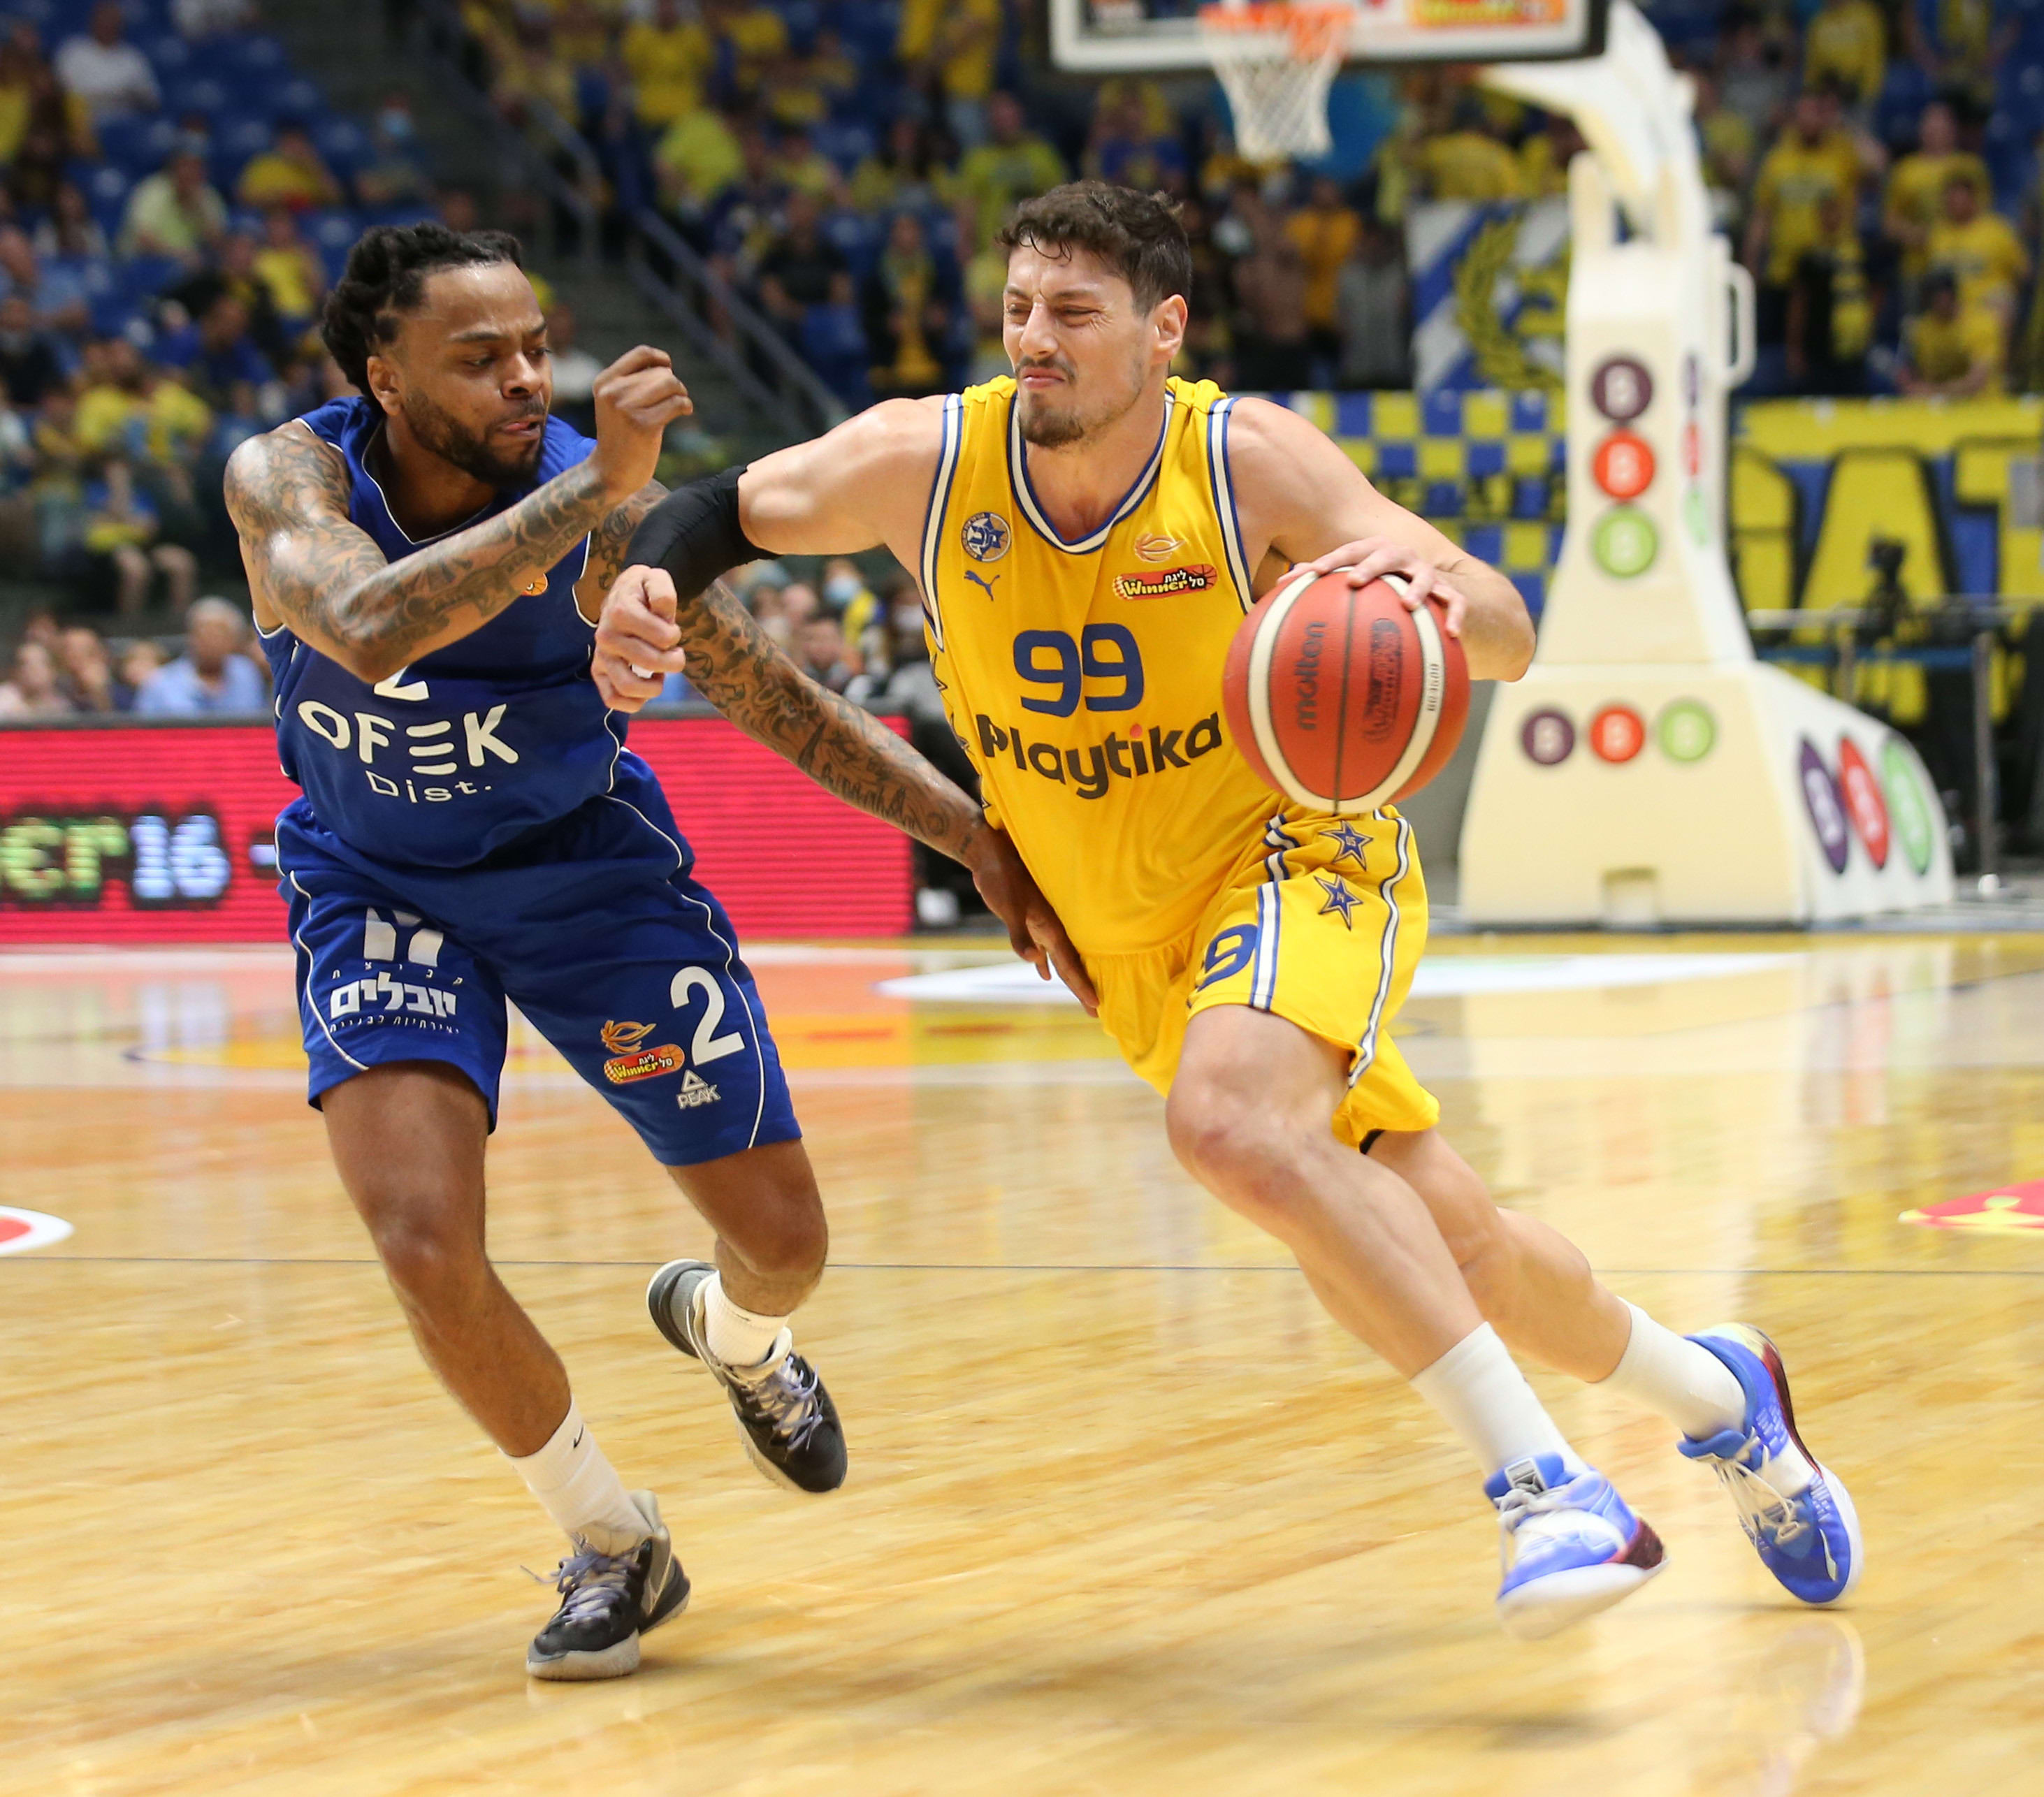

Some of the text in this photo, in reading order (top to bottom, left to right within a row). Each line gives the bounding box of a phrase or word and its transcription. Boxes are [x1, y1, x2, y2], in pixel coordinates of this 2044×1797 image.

[1123, 579, 1188, 595] Winner
[1013, 623, 1145, 718] 99
[1295, 621, 1327, 730] molten
[298, 700, 519, 776] OFEK
[976, 711, 1223, 800] Playtika
[365, 771, 492, 803] Dist.
[131, 815, 231, 898] 16
[330, 971, 457, 1020] יובלים
[670, 966, 745, 1066] 2
[614, 1061, 659, 1079] Winner
[676, 1084, 722, 1110] PEAK
